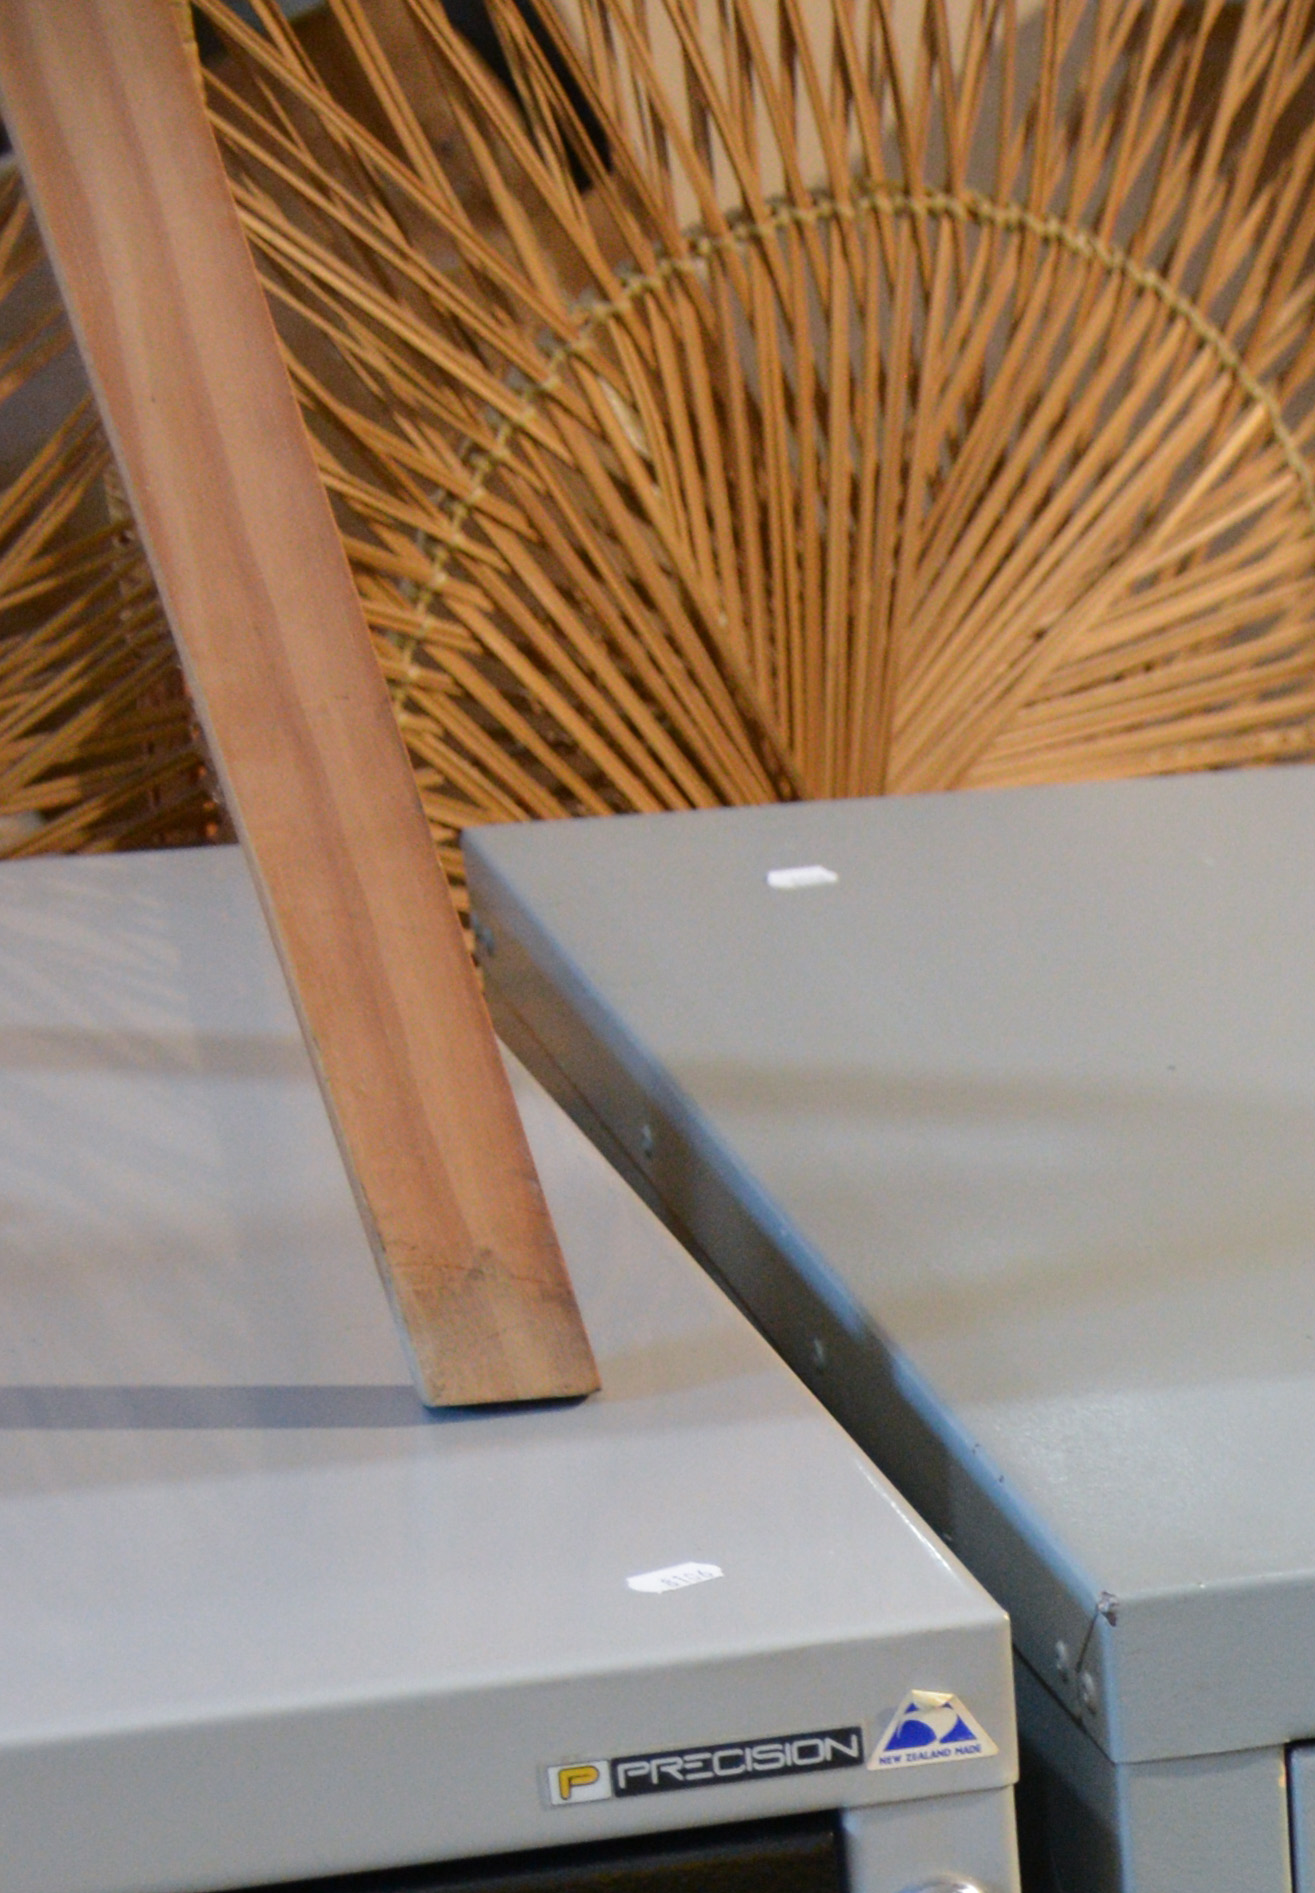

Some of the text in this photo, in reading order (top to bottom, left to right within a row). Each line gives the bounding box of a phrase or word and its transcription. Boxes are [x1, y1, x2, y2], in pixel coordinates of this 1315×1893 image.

[615, 1733, 860, 1789] PRECISION
[879, 1744, 982, 1765] NEW ZEALAND MADE
